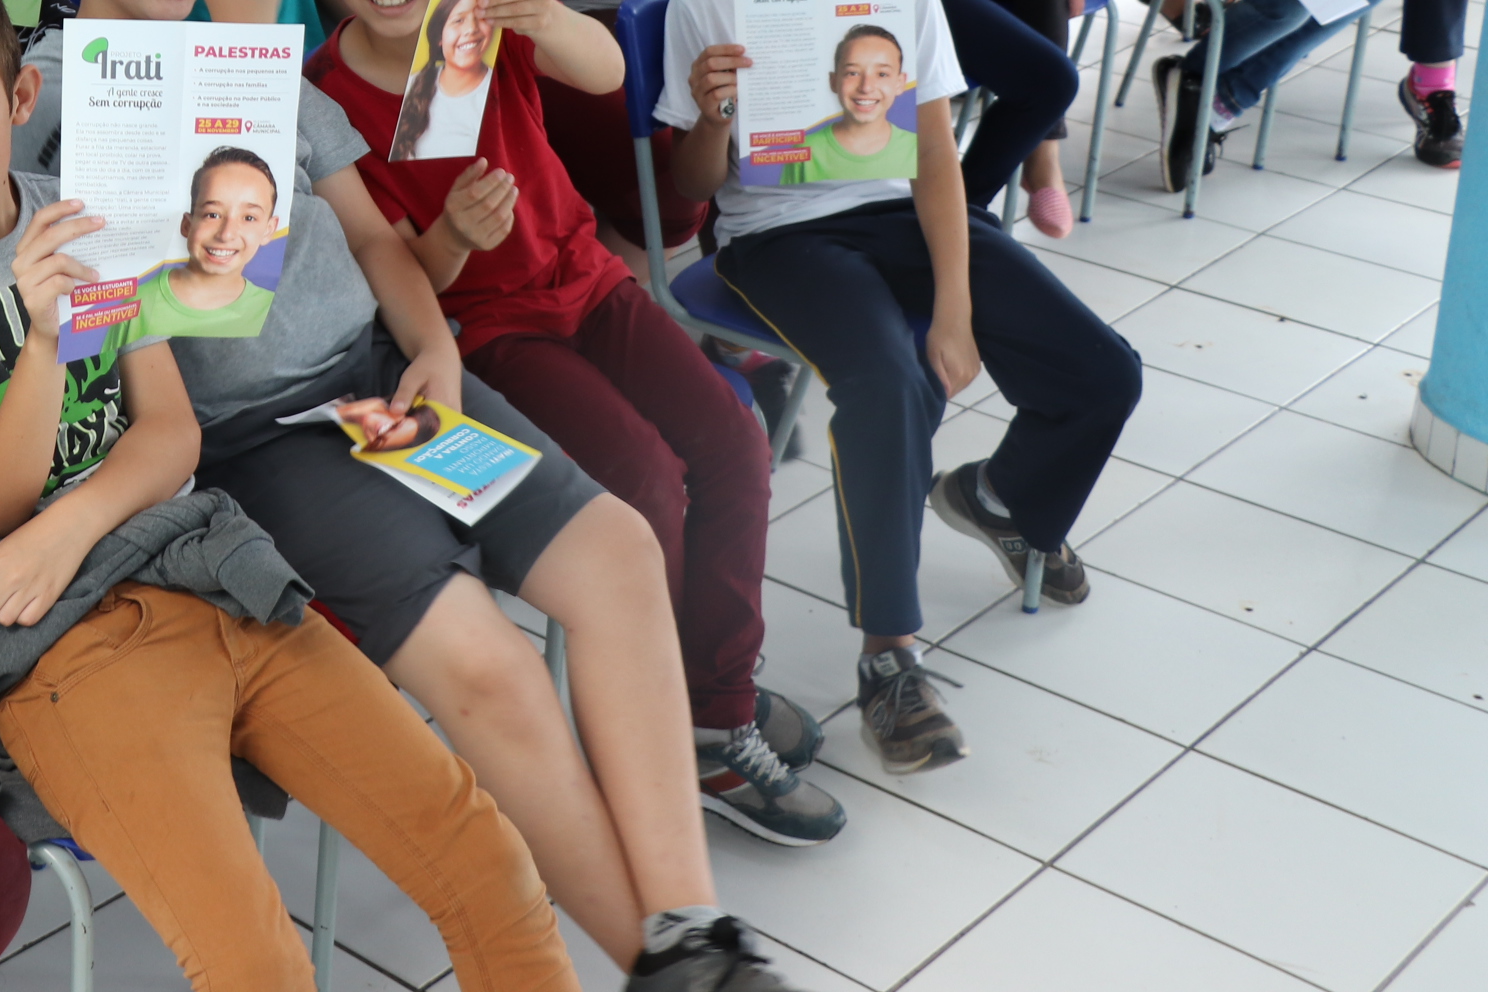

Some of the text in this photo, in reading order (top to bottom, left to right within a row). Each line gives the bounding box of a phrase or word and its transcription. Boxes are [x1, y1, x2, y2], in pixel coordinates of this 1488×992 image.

[194, 45, 291, 59] PALESTRAS
[94, 50, 163, 80] Irati
[107, 87, 114, 97] A
[117, 88, 137, 98] gente
[89, 96, 162, 110] Sem corrupção
[226, 120, 239, 128] 29
[103, 281, 133, 290] ESTUDANTE
[75, 287, 133, 304] PARTICIPE!
[76, 307, 136, 329] INCENTIVE!
